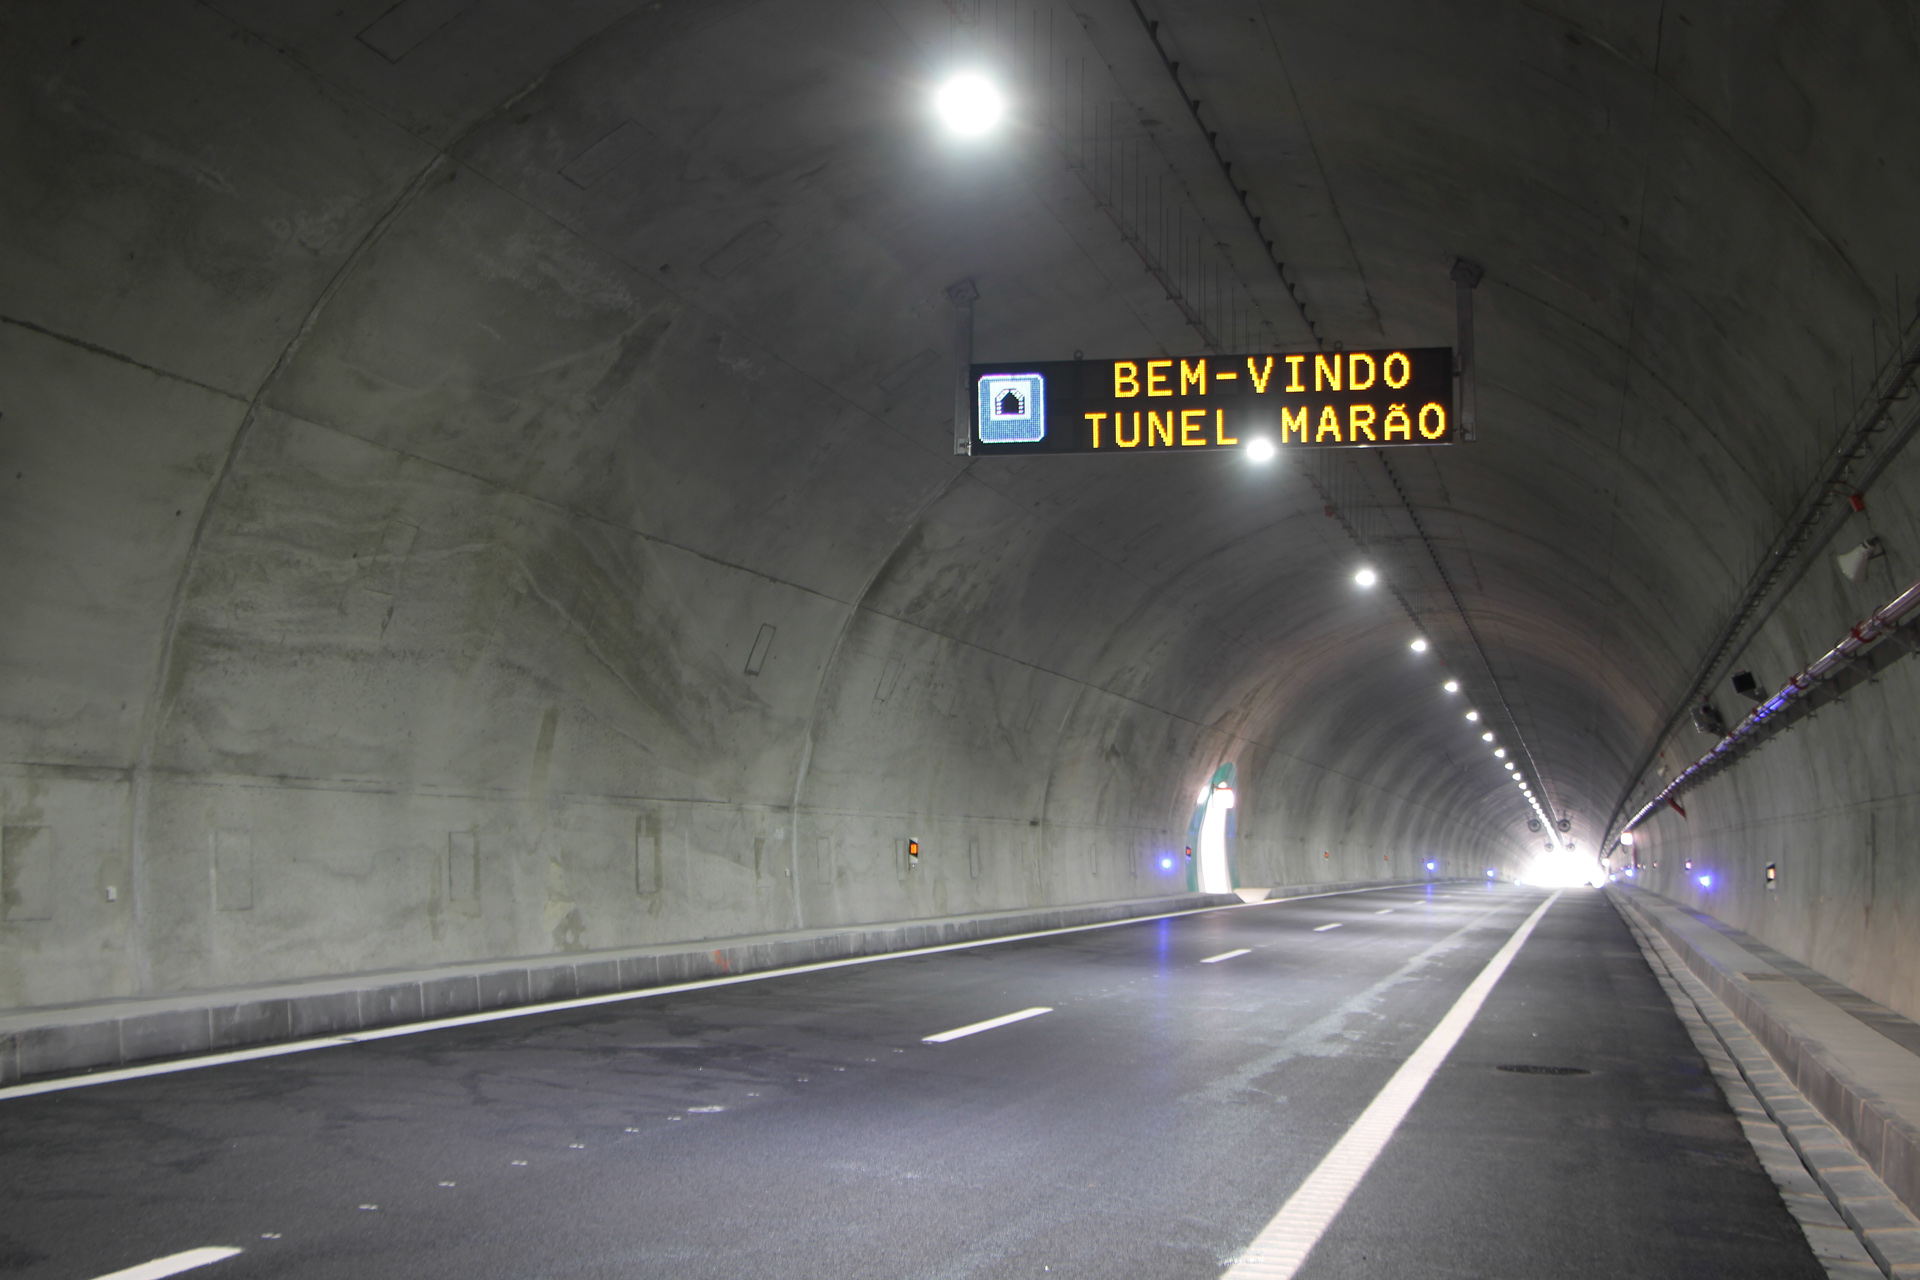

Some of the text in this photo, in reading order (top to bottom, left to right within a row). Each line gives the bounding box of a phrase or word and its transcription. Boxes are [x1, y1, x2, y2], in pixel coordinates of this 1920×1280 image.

[1114, 351, 1412, 398] BEM-VINDO
[1084, 401, 1447, 449] TUNEL MARÃO
